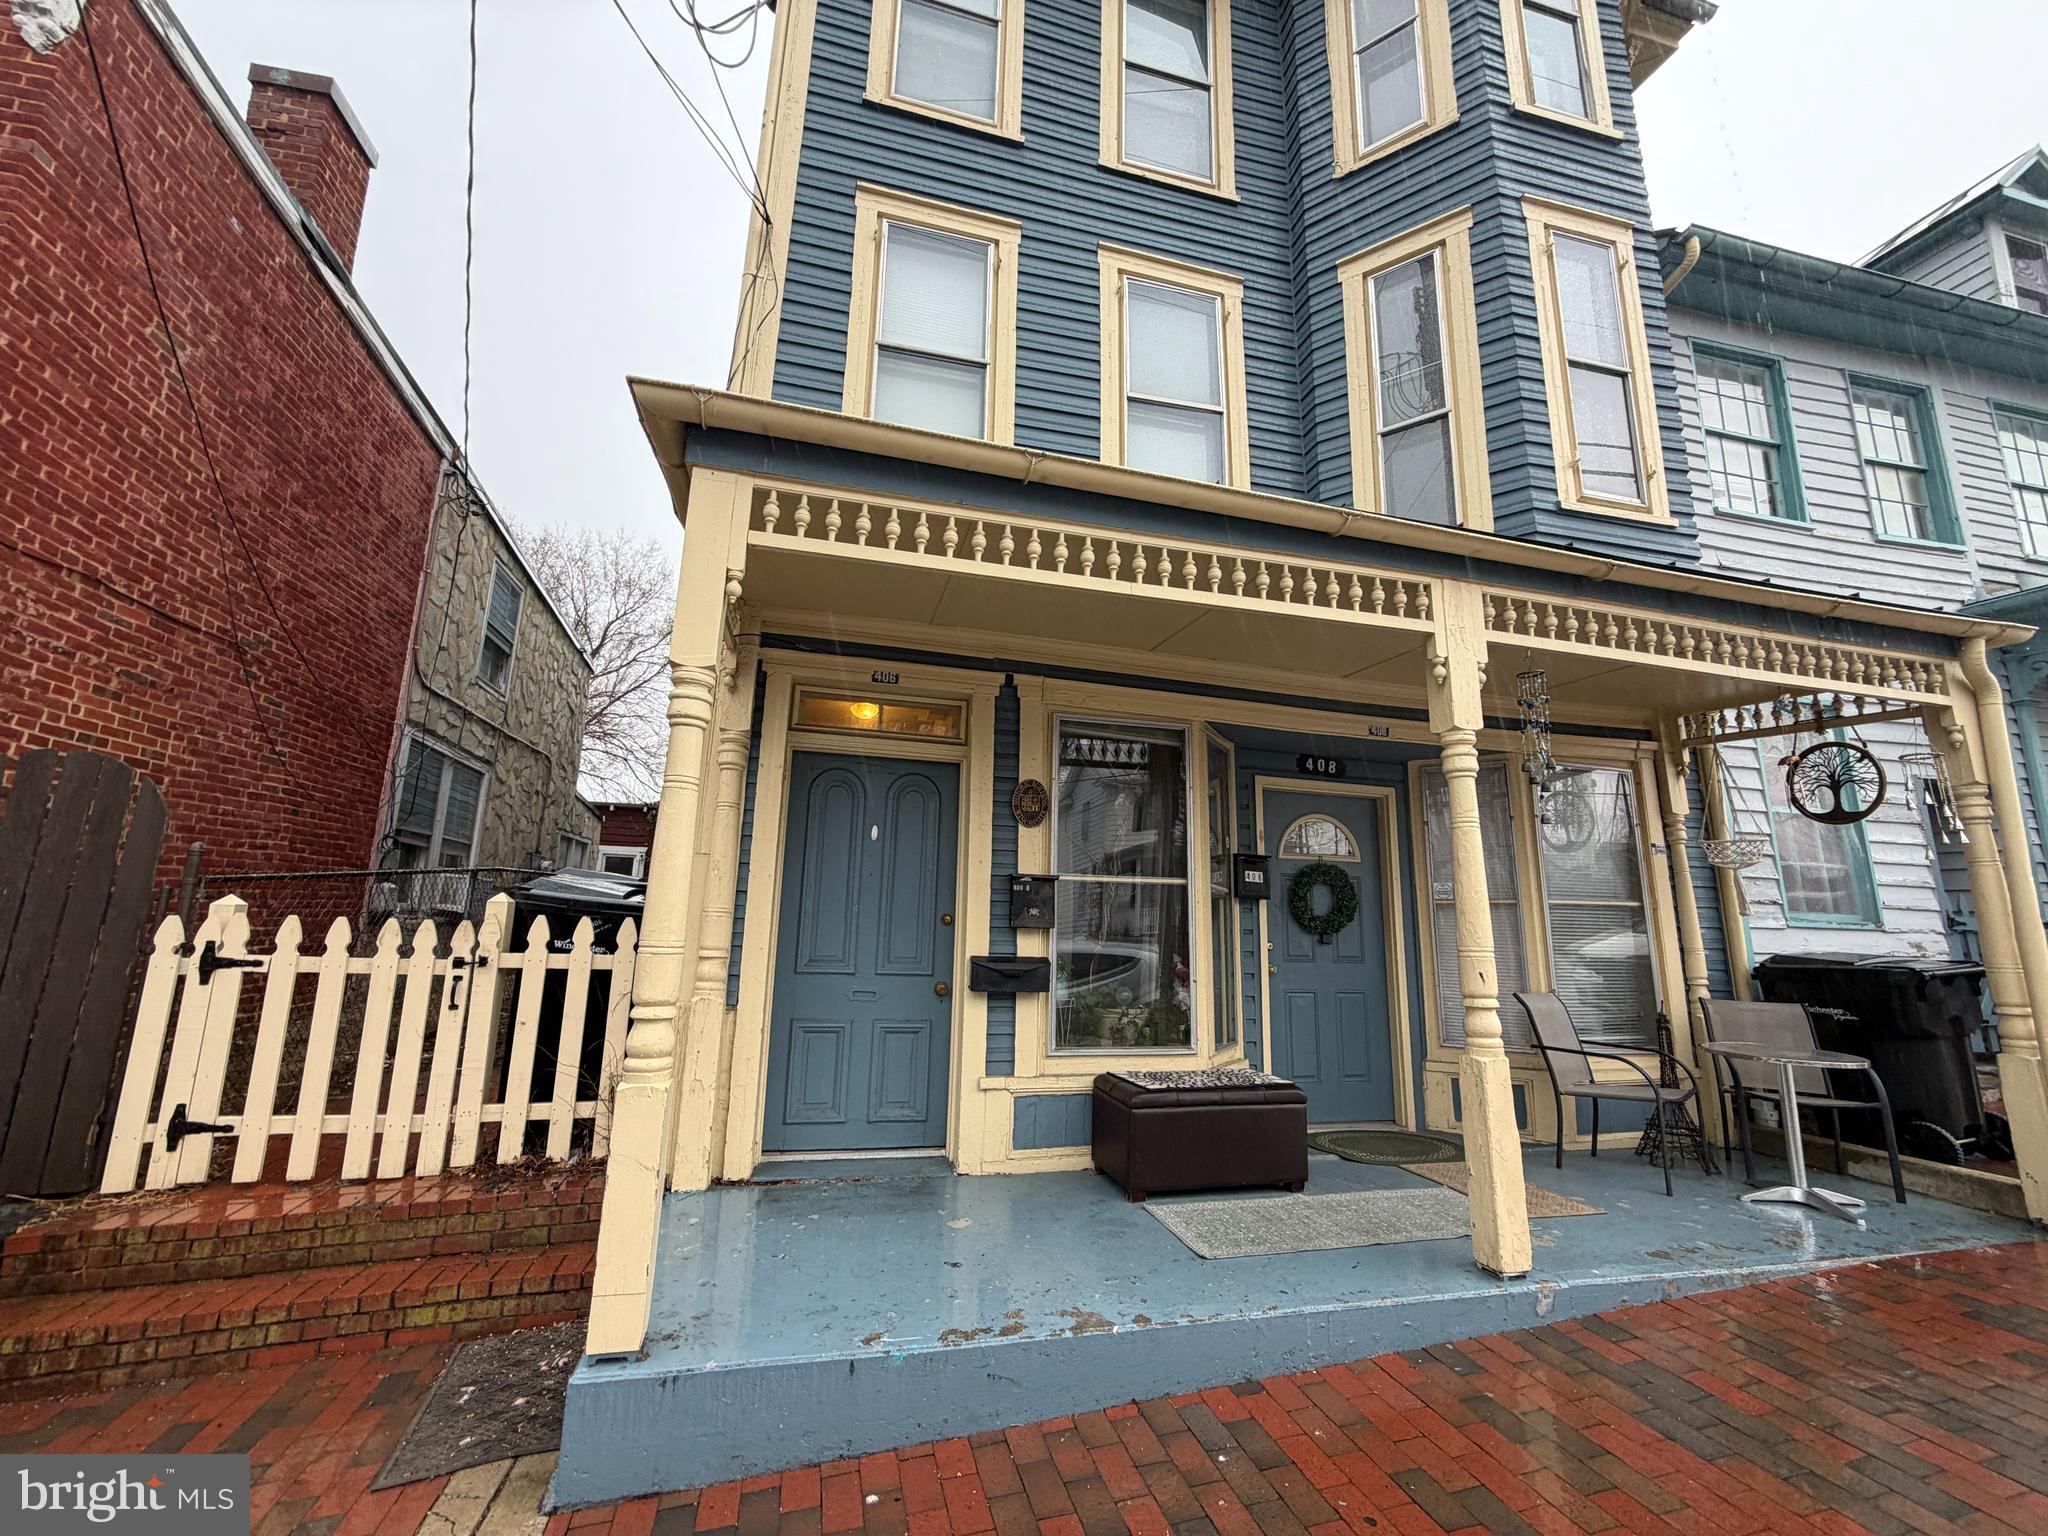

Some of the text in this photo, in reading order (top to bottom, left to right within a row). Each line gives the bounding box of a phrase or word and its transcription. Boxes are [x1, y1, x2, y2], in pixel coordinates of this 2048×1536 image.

[875, 671, 896, 683] 406
[1371, 726, 1387, 736] 408
[1306, 758, 1337, 774] 408
